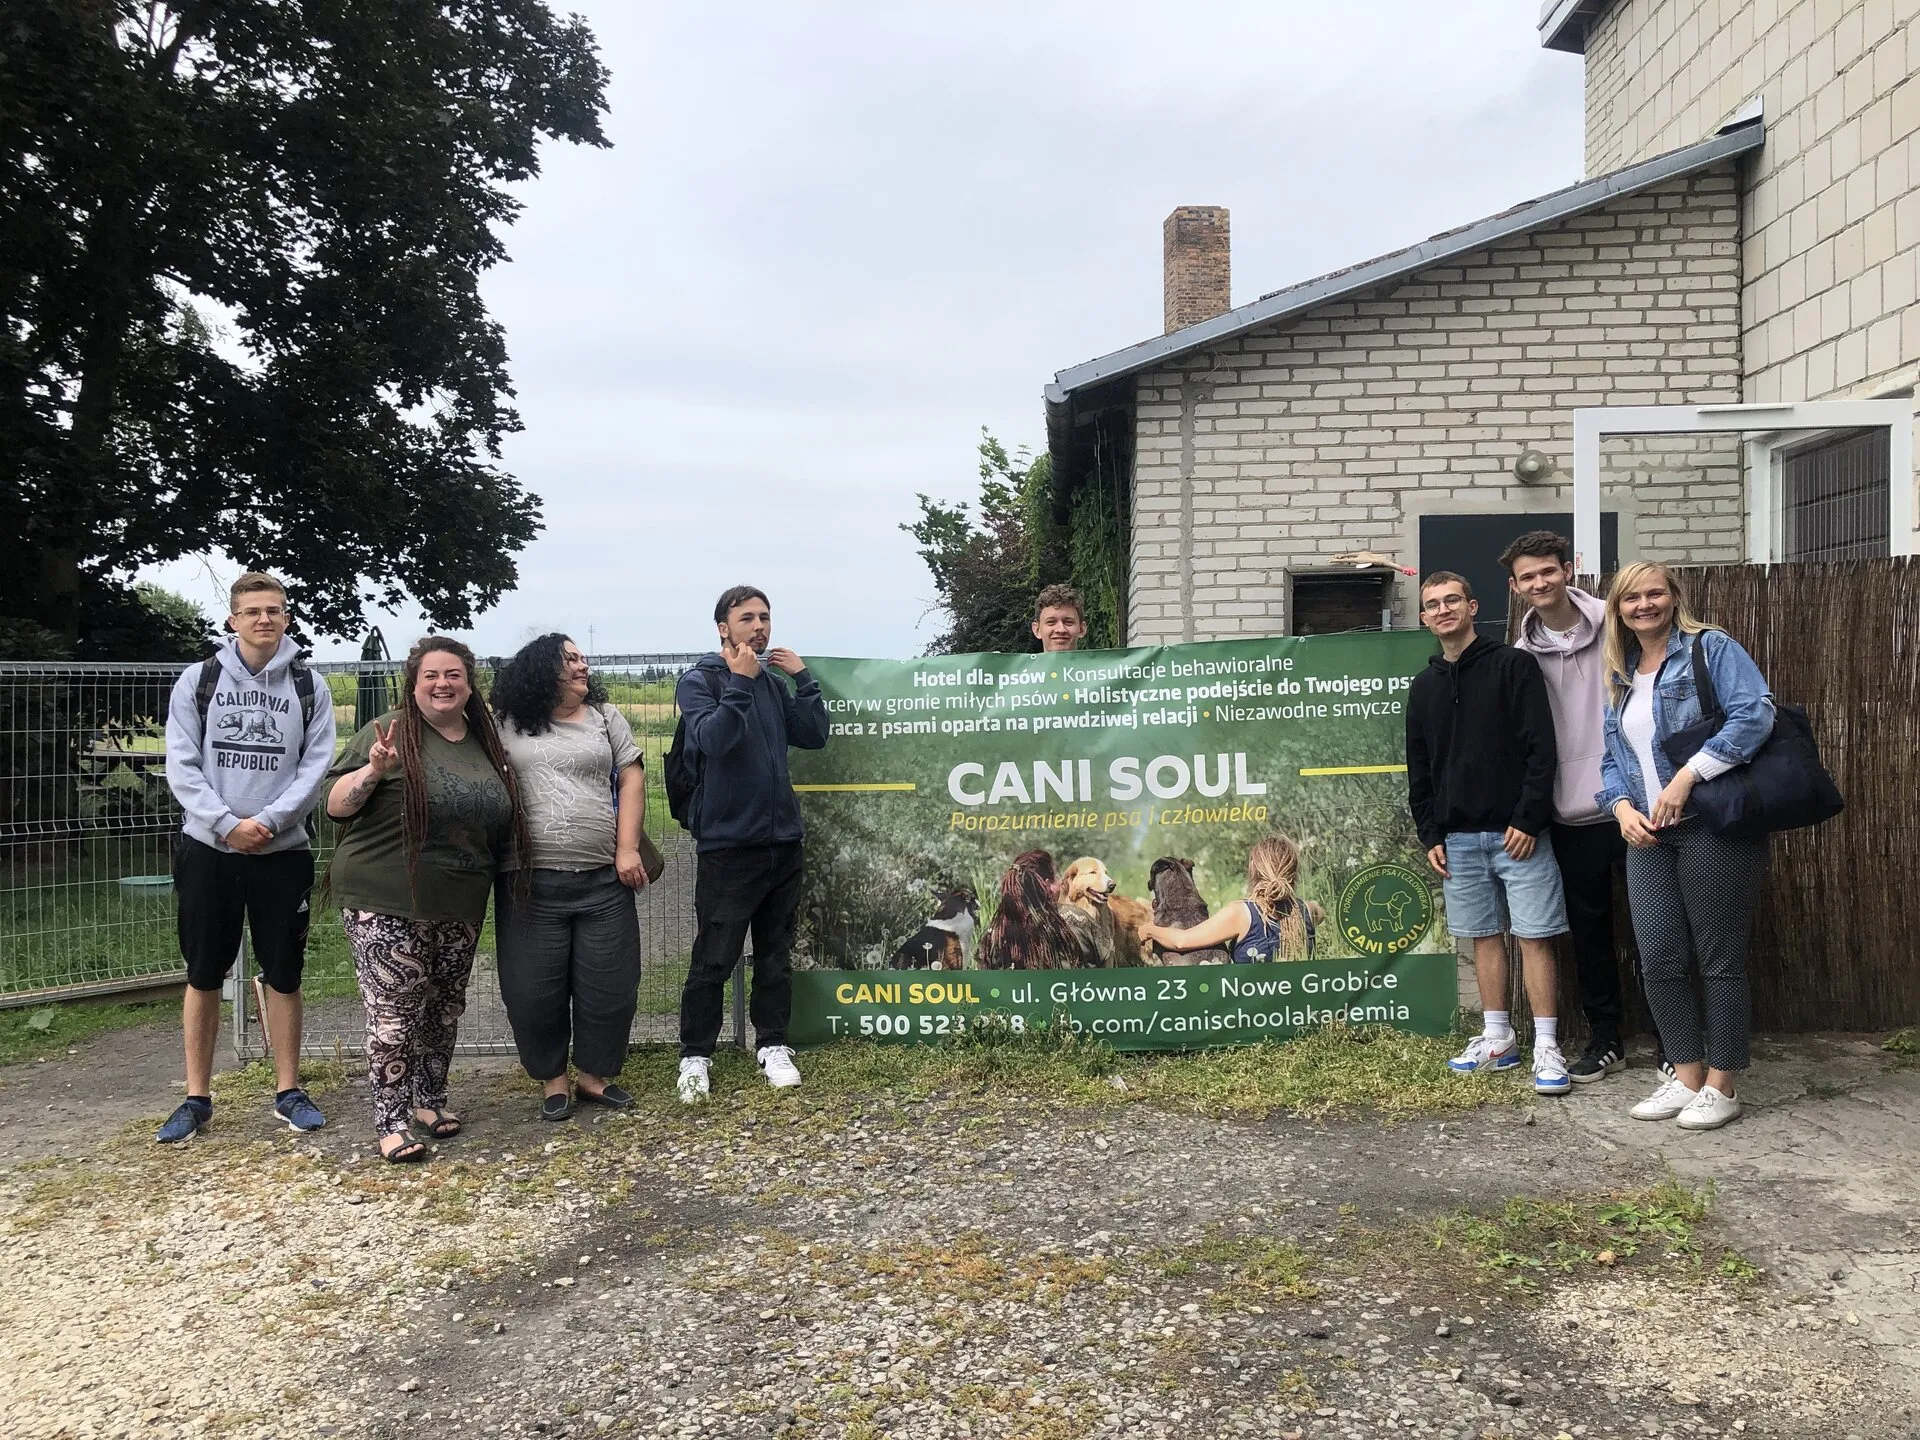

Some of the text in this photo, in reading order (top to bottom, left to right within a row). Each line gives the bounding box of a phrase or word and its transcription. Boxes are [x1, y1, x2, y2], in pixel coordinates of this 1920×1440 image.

[913, 655, 1294, 690] Hotel dla psów Konsultacje behawioralne
[867, 699, 881, 712] w
[886, 694, 940, 715] gronie
[946, 691, 1005, 712] miłych
[1011, 690, 1058, 711] psów
[1075, 685, 1182, 706] Holistyczne
[1187, 680, 1273, 704] podejście
[1277, 677, 1301, 695] do
[1304, 675, 1383, 696] Twojego
[829, 700, 1402, 739] raca z psami oparta na prawdziwej relacji Niezawodne smycze
[217, 752, 279, 771] REPUBLIC
[947, 752, 1268, 806] CANI SOUL
[950, 801, 1268, 832] Porozumienie psa i człowieka
[1381, 868, 1397, 876] PSA
[1347, 923, 1426, 954] CANI SOUL
[836, 969, 1399, 1004] CANI SOUL ul. Główna 23 Nowe Grobice
[826, 1015, 849, 1035] T:
[859, 1014, 911, 1035] 500
